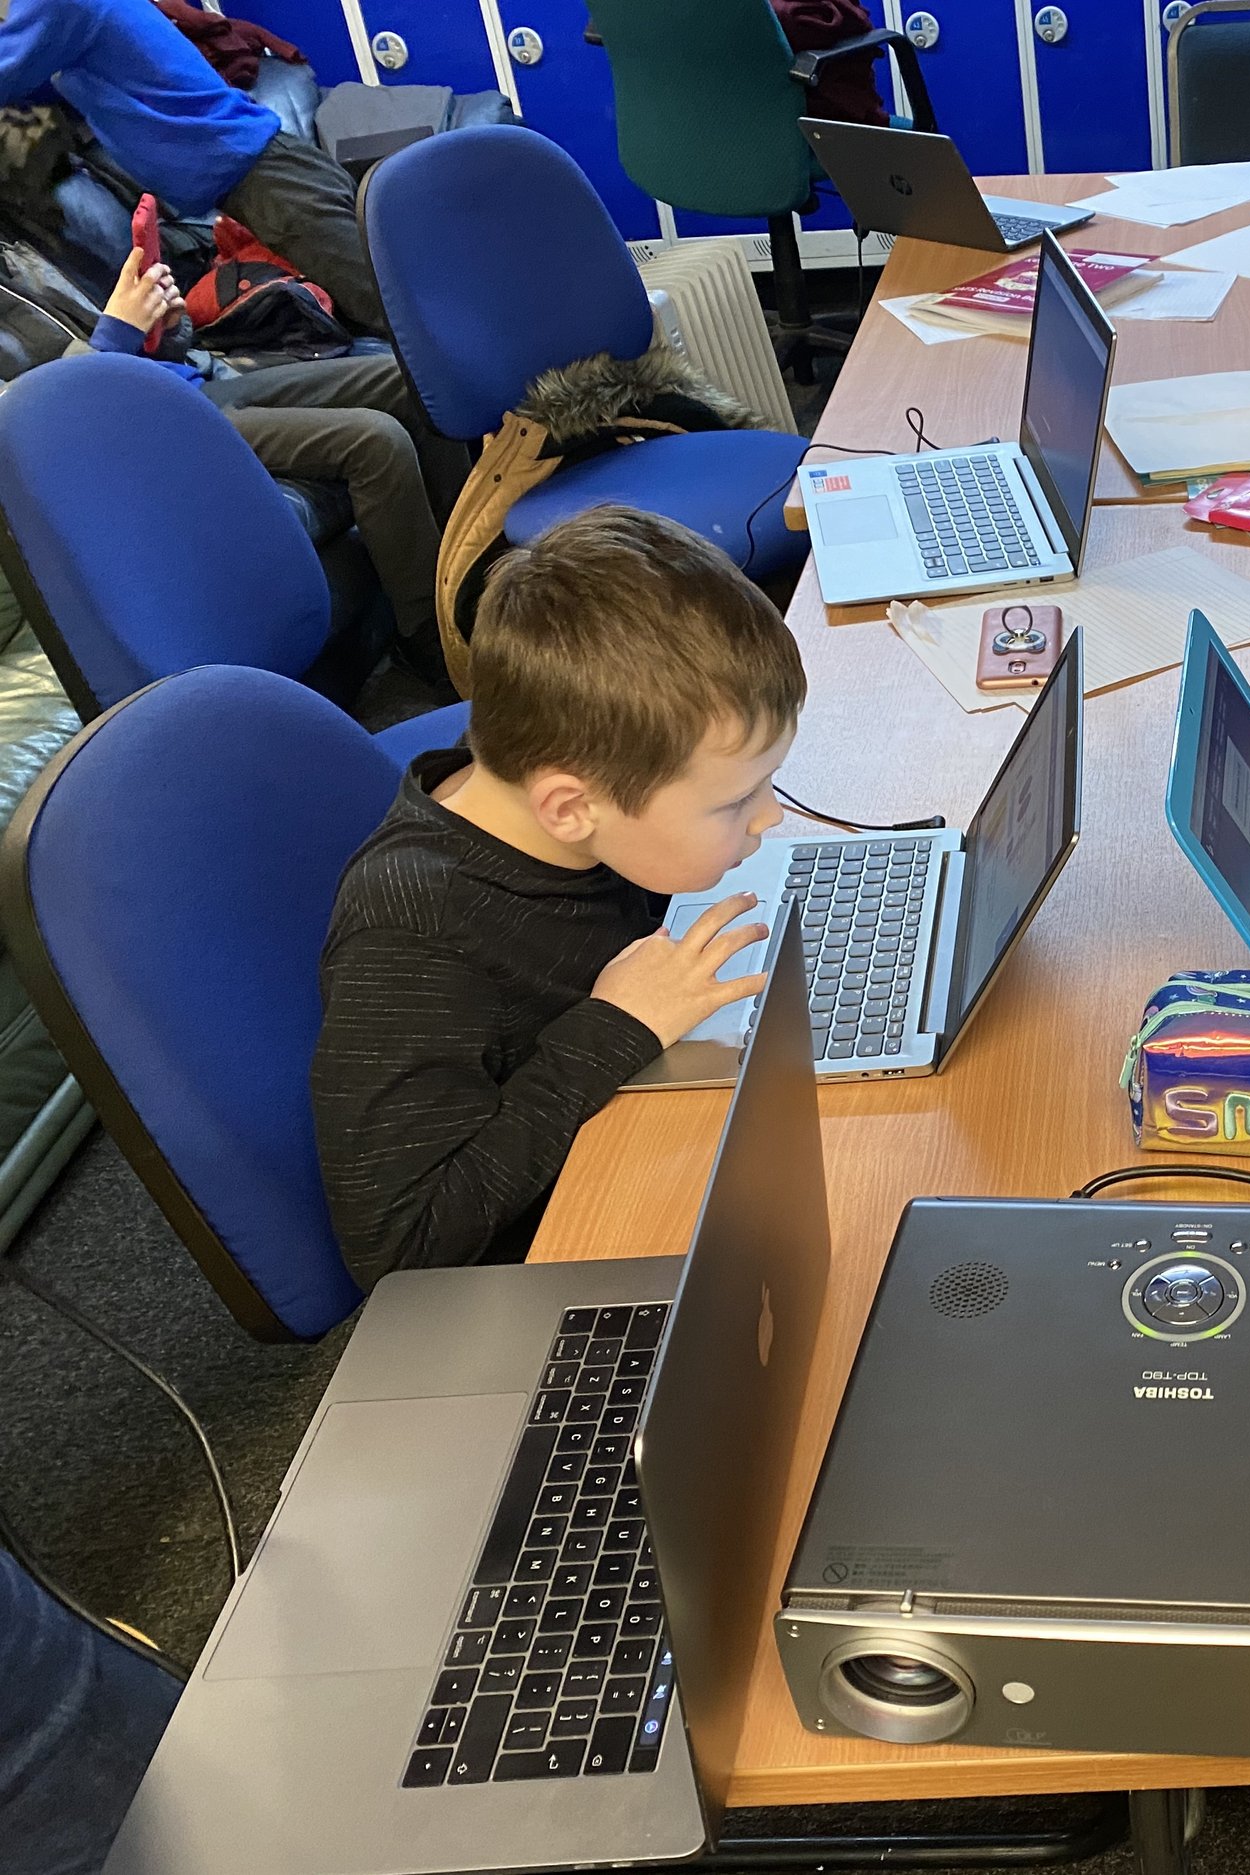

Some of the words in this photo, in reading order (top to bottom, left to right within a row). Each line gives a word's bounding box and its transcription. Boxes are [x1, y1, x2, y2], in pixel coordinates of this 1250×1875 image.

[977, 287, 1022, 299] Revision
[1142, 1371, 1208, 1381] TDP-T90
[1133, 1387, 1214, 1400] TOSHIBA
